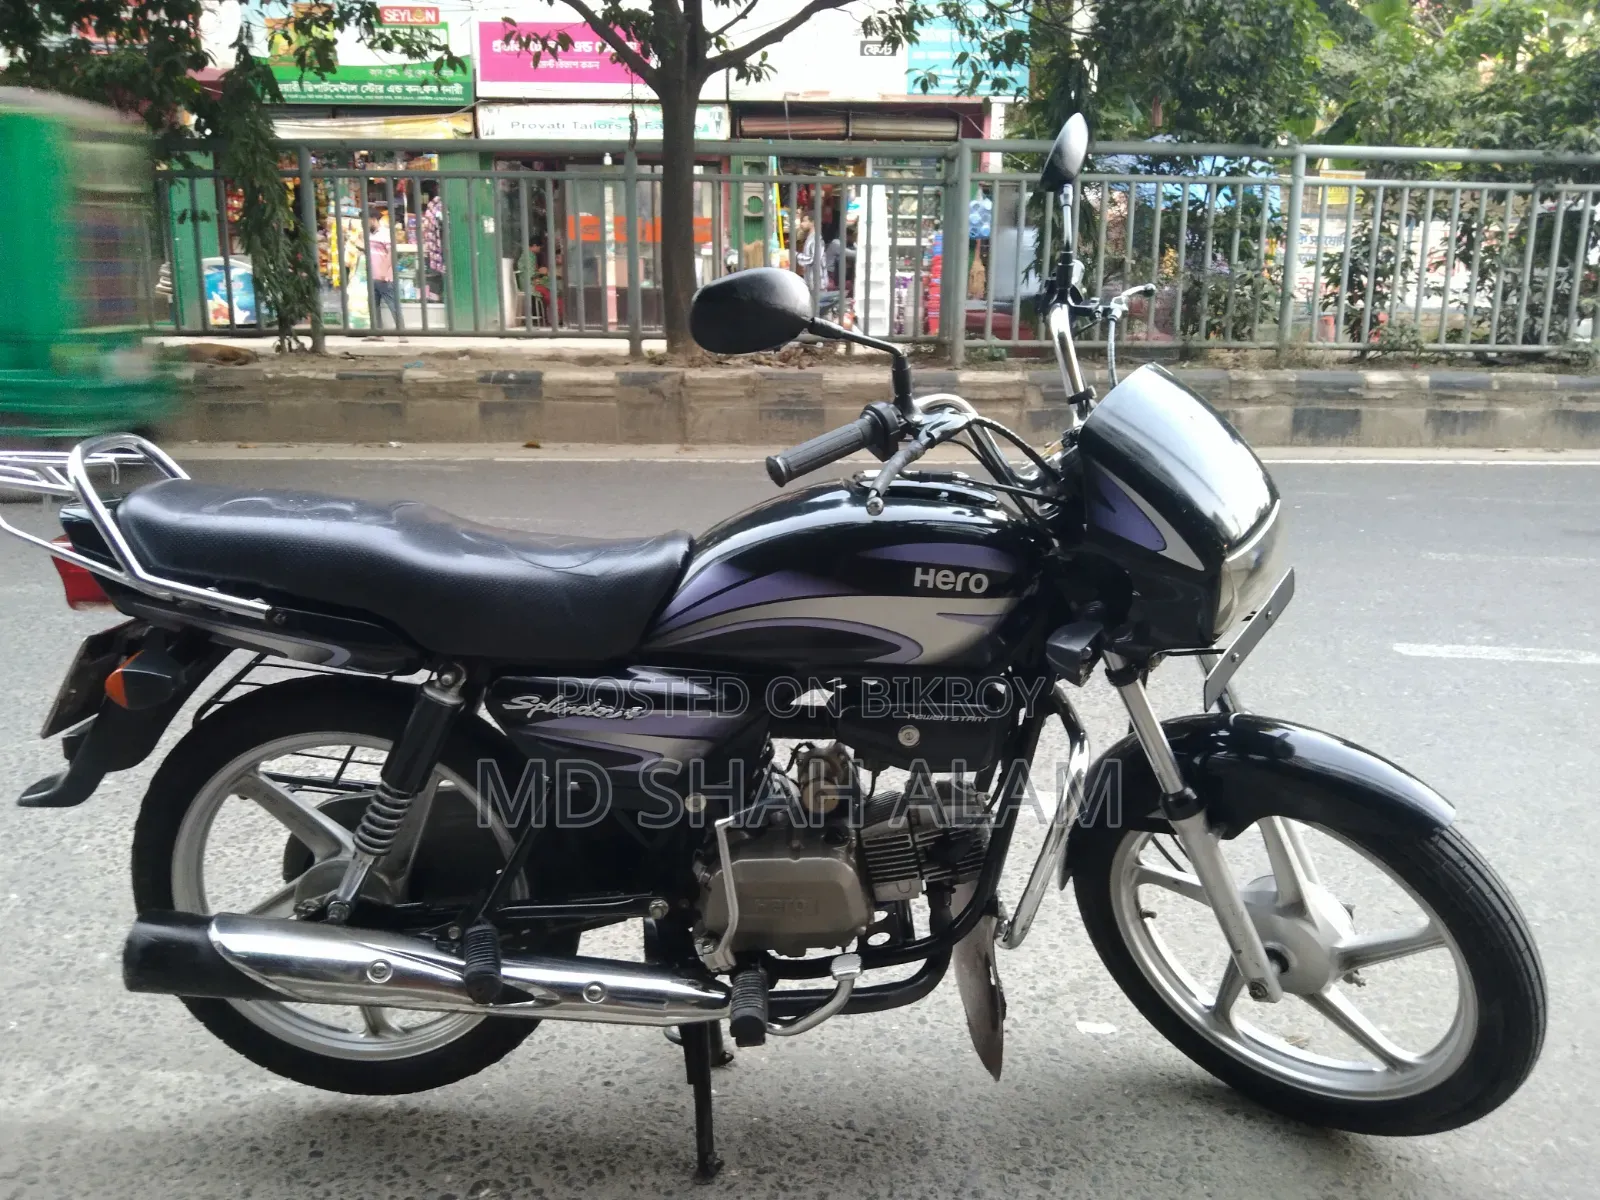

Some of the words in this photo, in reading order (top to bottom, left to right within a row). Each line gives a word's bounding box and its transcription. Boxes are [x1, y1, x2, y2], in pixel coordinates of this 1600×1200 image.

[384, 8, 436, 23] SEYLON
[572, 120, 623, 130] Tailors
[913, 567, 990, 594] Hero
